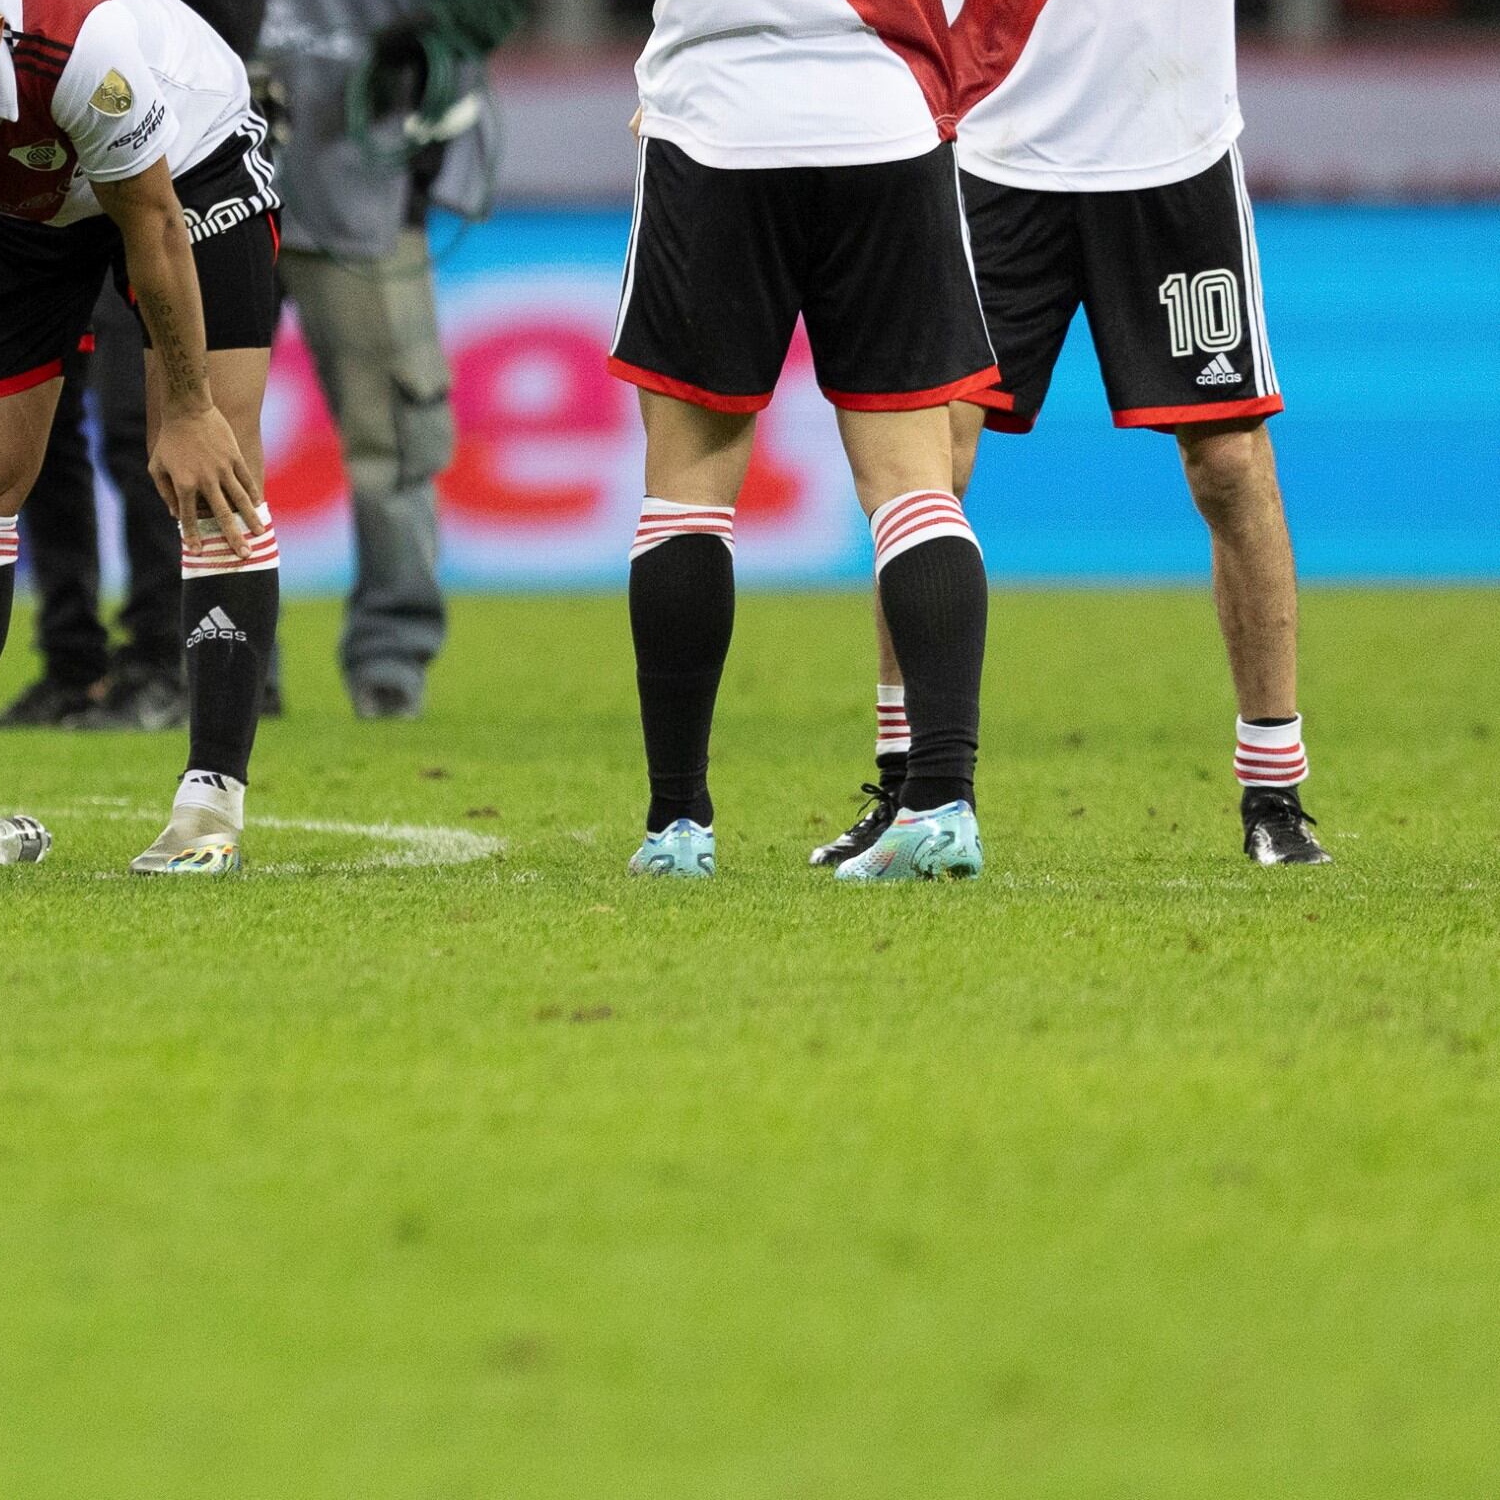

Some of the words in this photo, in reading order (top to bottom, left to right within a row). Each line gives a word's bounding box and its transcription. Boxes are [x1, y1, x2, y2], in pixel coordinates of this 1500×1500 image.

[107, 99, 158, 152] ASSIST
[132, 105, 165, 150] CARD
[1158, 268, 1242, 357] 10
[1195, 373, 1242, 385] adidas
[186, 628, 247, 648] adidas
